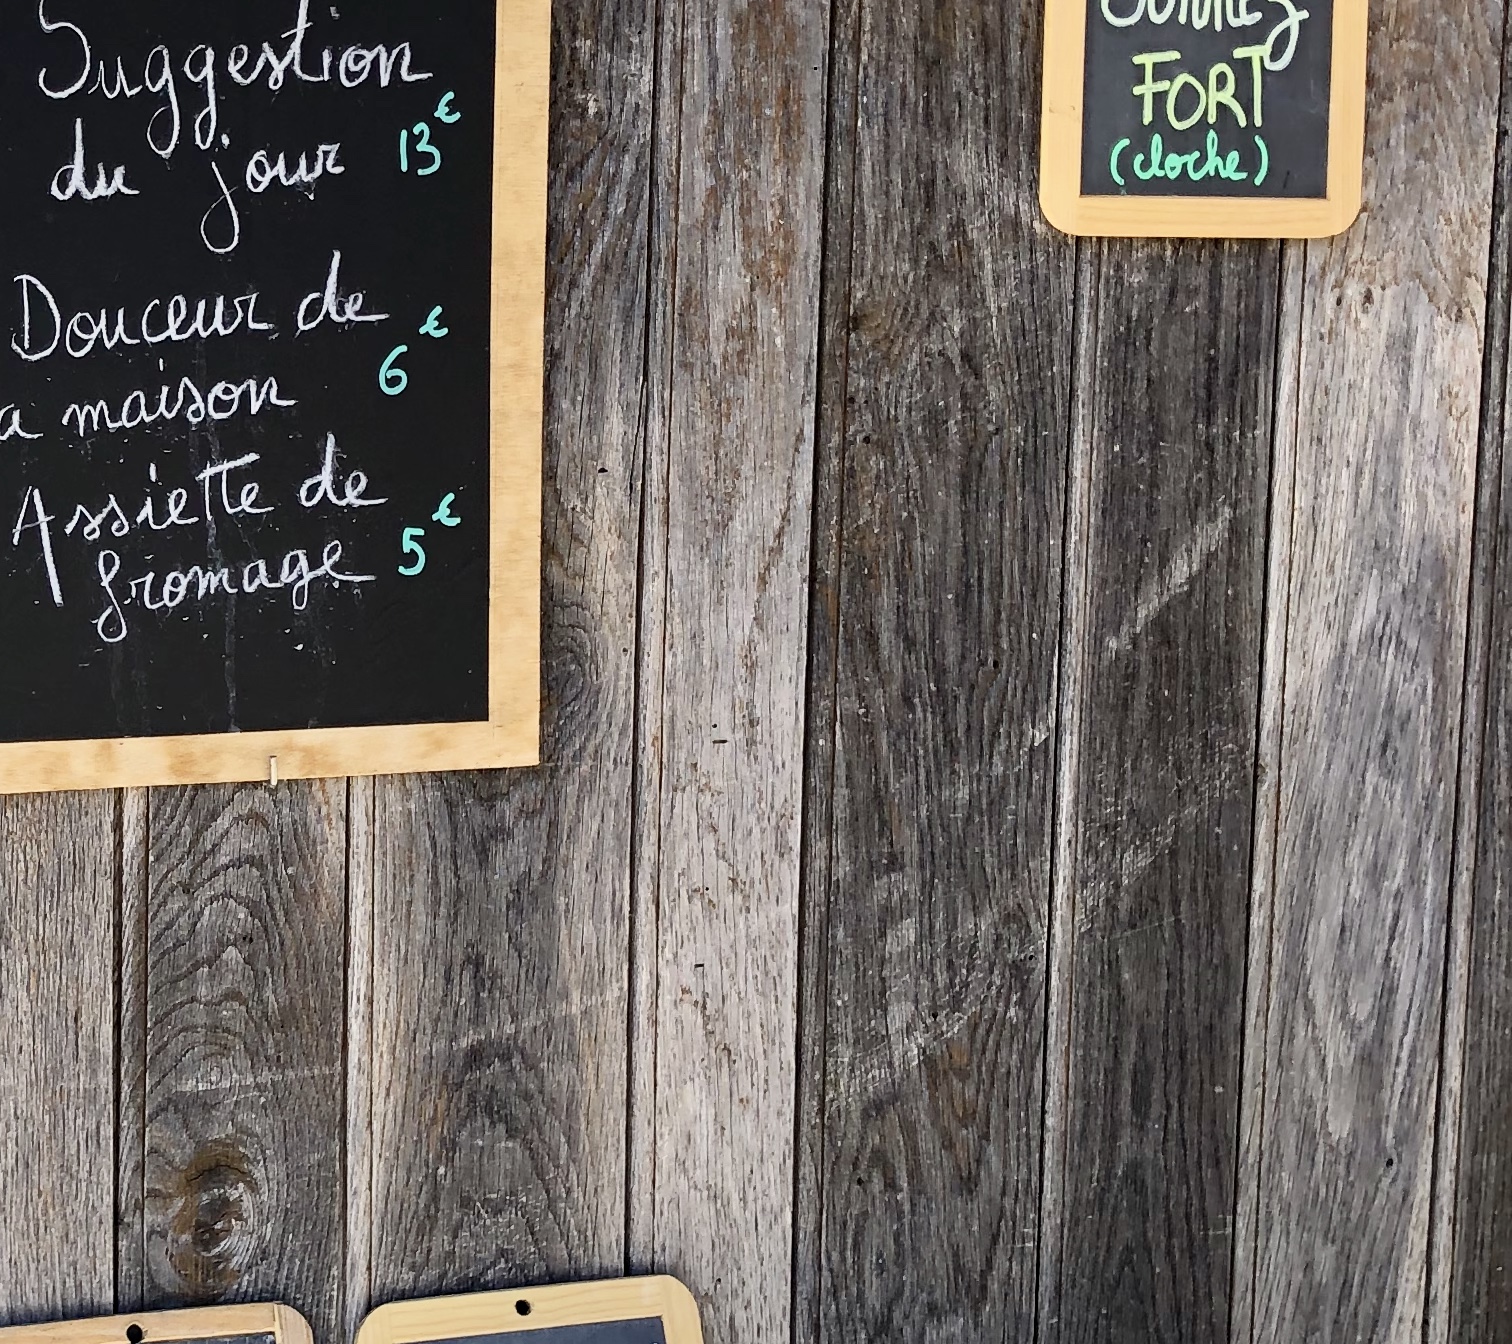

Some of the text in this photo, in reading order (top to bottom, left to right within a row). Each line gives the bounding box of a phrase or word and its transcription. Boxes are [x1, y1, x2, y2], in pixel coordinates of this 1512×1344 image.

[1131, 45, 1271, 130] FORT
[51, 118, 140, 201] du
[200, 133, 346, 254] jour
[1110, 129, 1269, 186] (cloche)
[12, 273, 276, 361] Douceur
[297, 251, 389, 331] de
[62, 359, 297, 437] maison
[12, 453, 276, 607] Assiette
[300, 432, 388, 507] de
[95, 539, 378, 641] fromage
